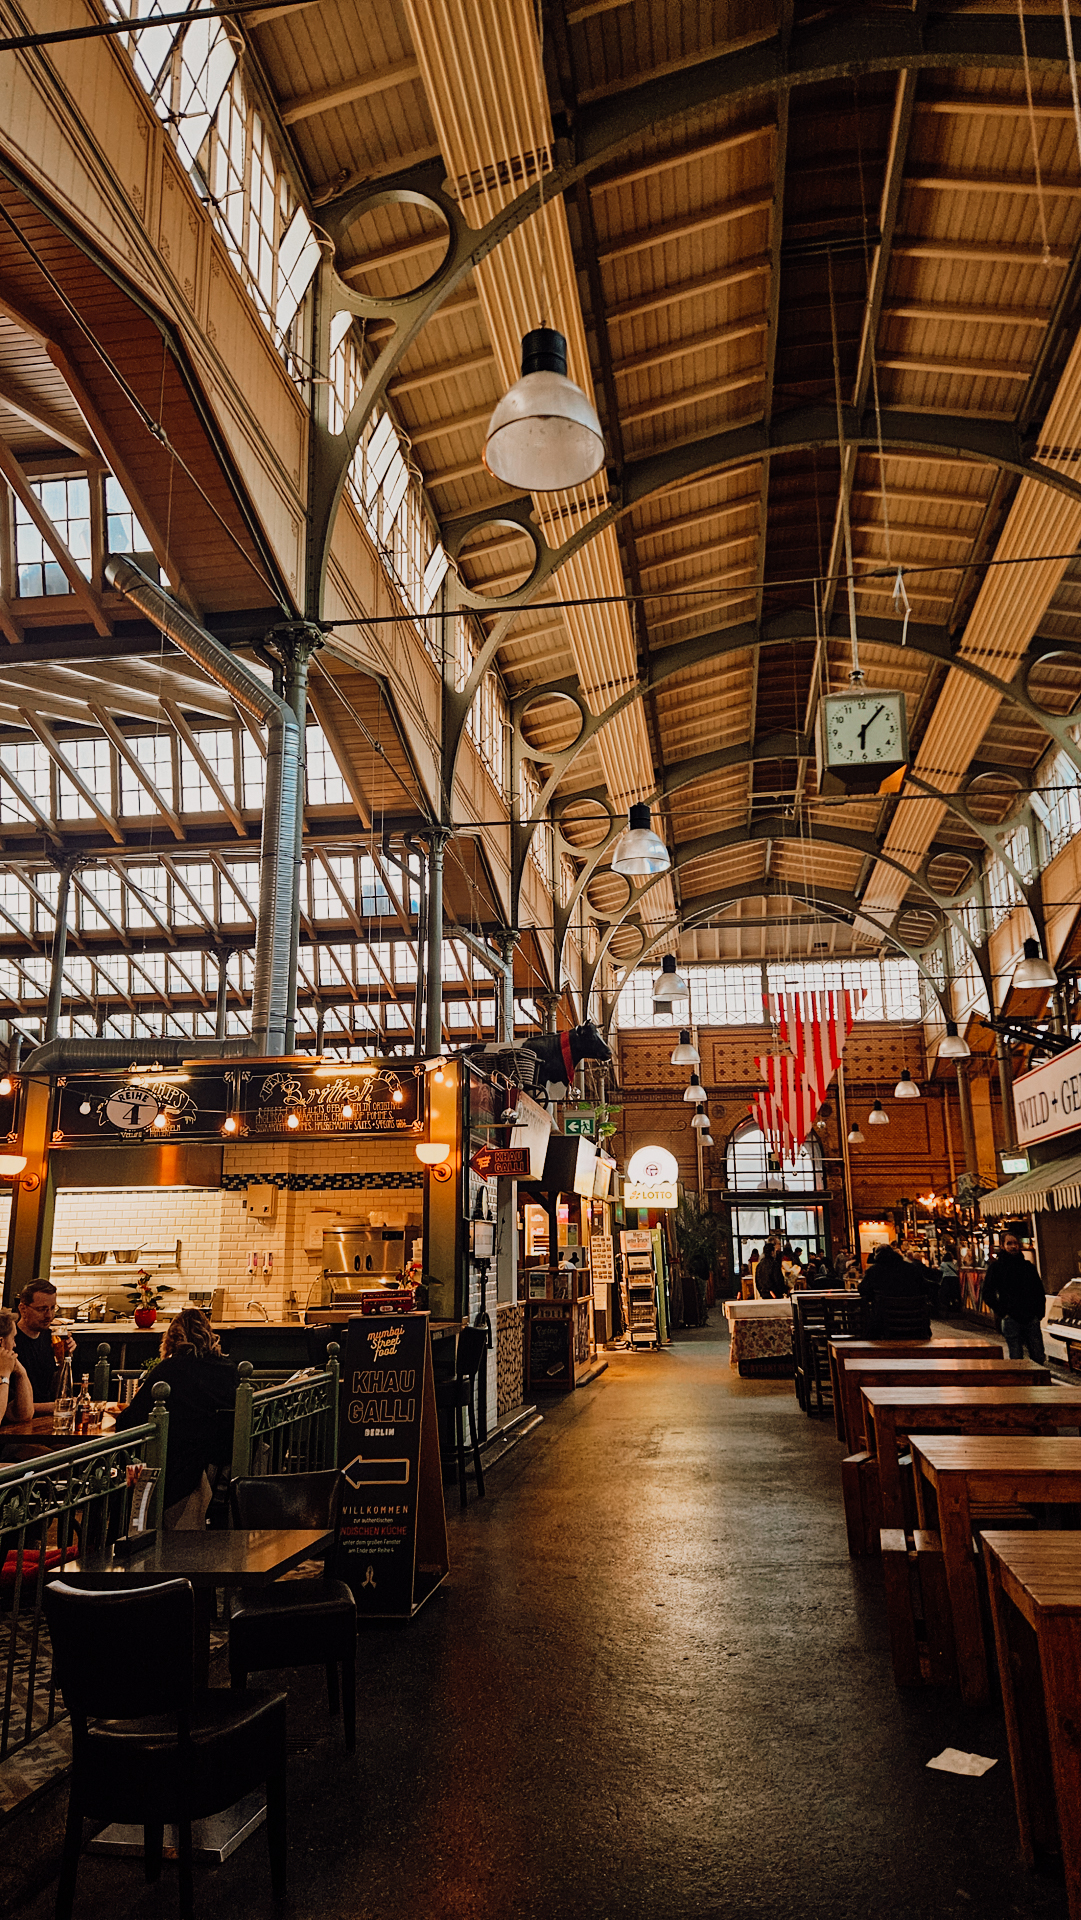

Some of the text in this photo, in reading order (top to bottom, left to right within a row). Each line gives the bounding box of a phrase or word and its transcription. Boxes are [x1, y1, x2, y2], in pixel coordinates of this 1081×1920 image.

[885, 713, 890, 721] 2
[889, 725, 895, 733] 3
[118, 1092, 149, 1102] REIHE
[152, 1083, 185, 1108] CHIPS
[281, 1078, 373, 1106] British
[362, 1103, 371, 1111] IN
[1018, 1092, 1049, 1131] WILD
[1061, 1073, 1081, 1115] GE
[123, 1104, 141, 1125] 4
[354, 1120, 372, 1130] SAUCES
[494, 1151, 523, 1162] KHAU
[494, 1161, 525, 1172] GALLI
[643, 1191, 672, 1200] LOTTO
[367, 1324, 405, 1341] mumbai
[373, 1346, 397, 1362] food
[352, 1369, 416, 1393] KHAU
[347, 1399, 416, 1423] GALLI
[364, 1428, 395, 1436] BERLIN
[381, 1525, 407, 1535] KÜCHE
